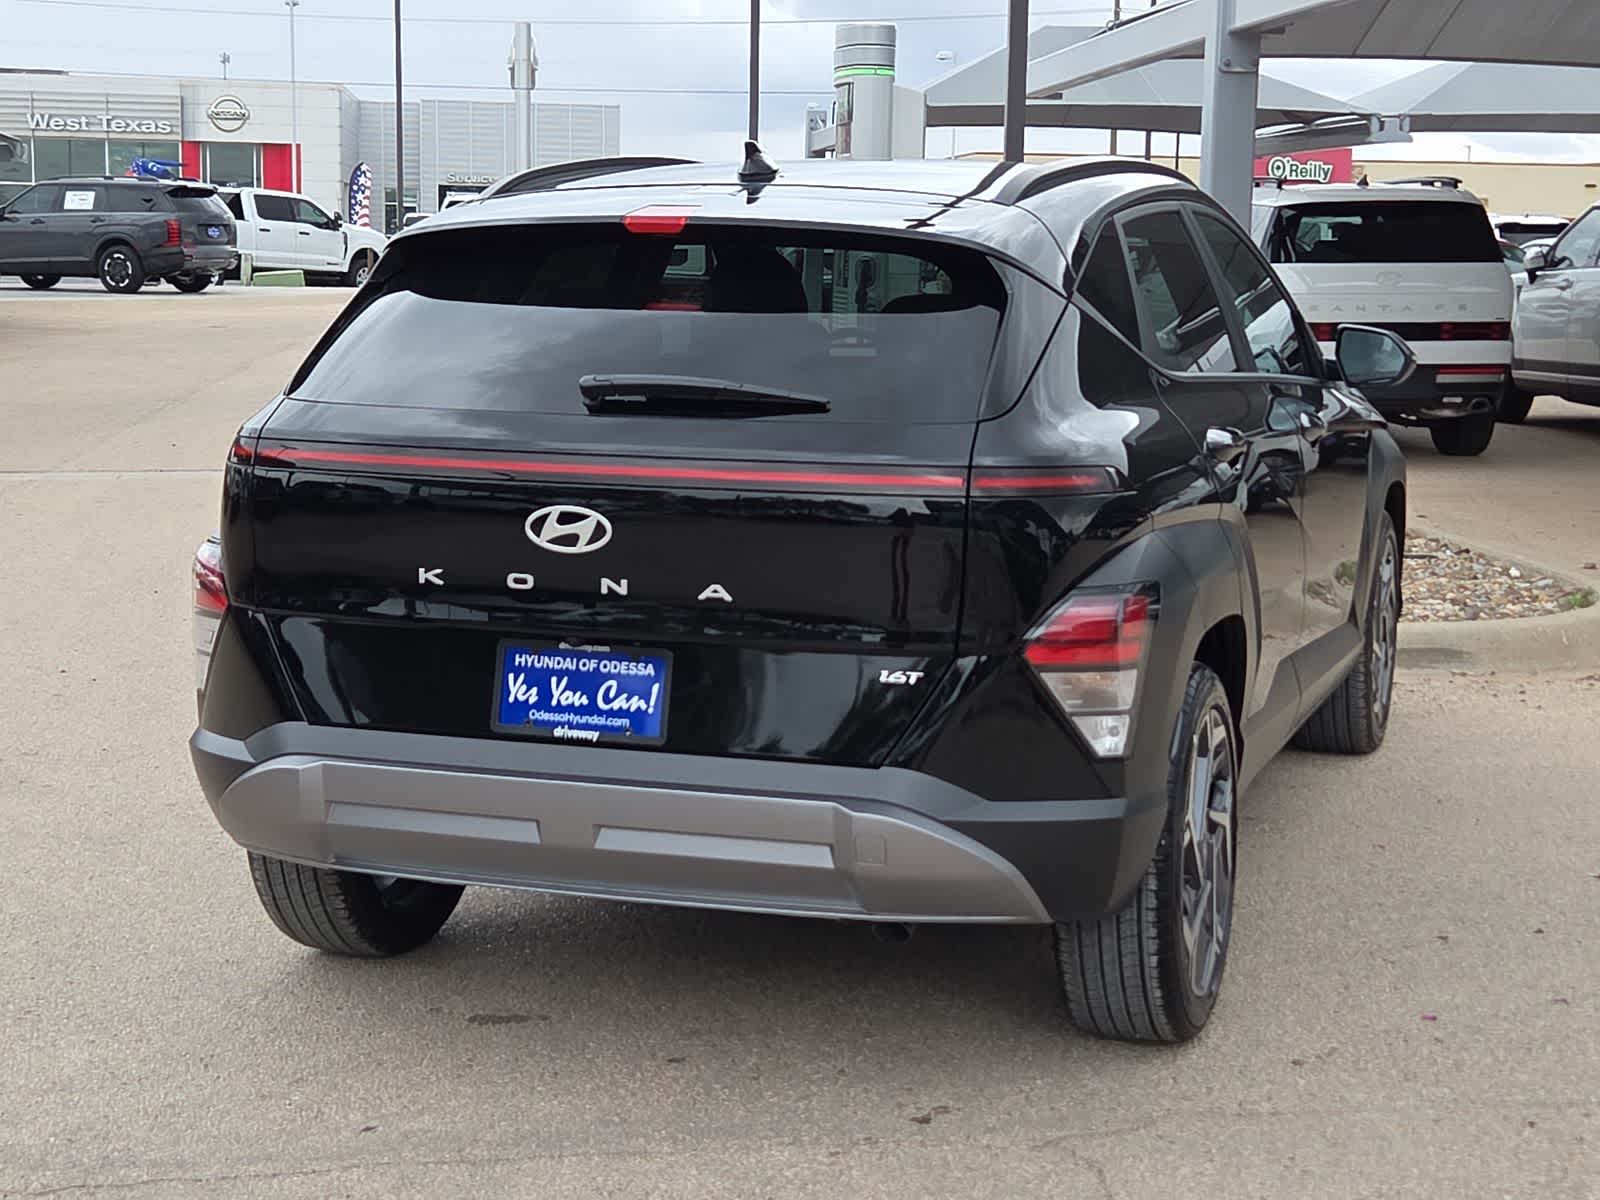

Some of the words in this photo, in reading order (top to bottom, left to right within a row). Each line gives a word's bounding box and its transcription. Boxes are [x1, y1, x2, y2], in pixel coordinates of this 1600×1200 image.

[26, 112, 89, 131] West
[97, 114, 172, 134] Texas
[1269, 157, 1333, 182] O'Reilly
[1308, 303, 1413, 313] SANTA
[418, 567, 733, 602] KONA
[514, 653, 577, 671] HYUNDAI
[578, 658, 598, 673] OF
[599, 660, 656, 677] ODESSA
[507, 672, 539, 705] Yes
[550, 675, 590, 707] You
[596, 679, 661, 714] Can!
[528, 708, 631, 728] OdessaHyundai.com
[553, 724, 600, 743] driveway
